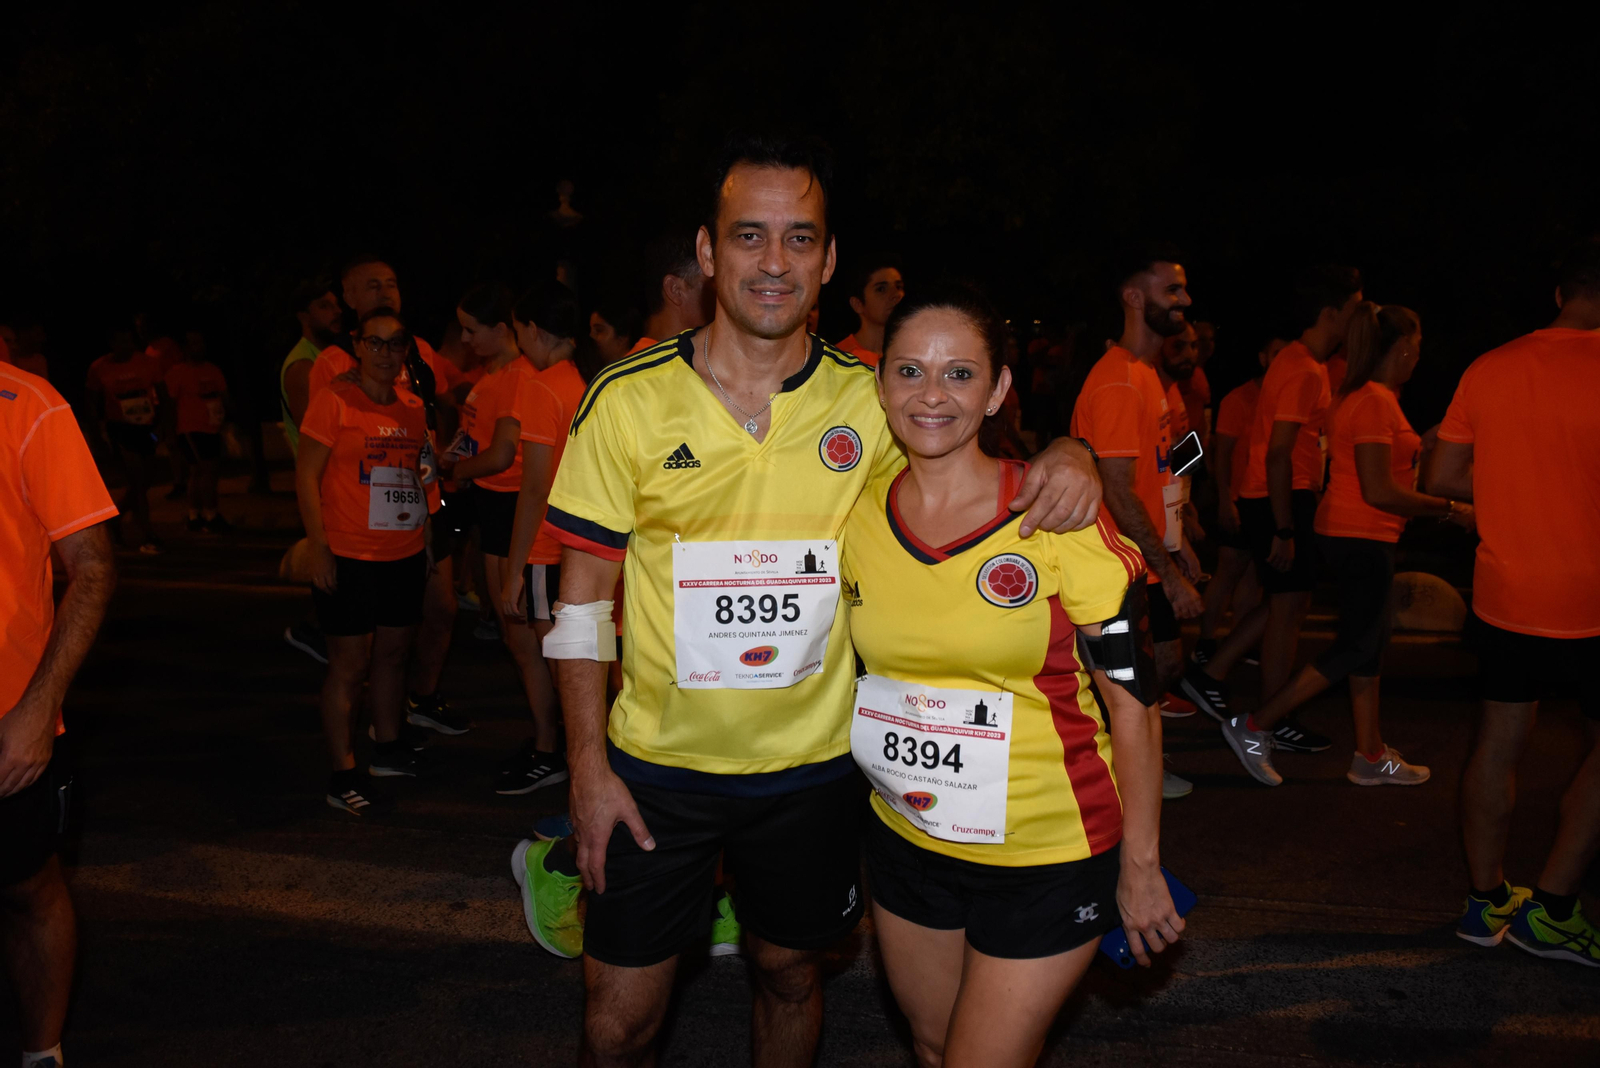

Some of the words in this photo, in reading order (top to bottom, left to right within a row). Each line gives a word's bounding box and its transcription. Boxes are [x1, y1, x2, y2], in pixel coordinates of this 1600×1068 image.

[663, 459, 702, 470] adidas
[384, 490, 420, 504] 19658
[715, 593, 801, 625] 8395
[708, 631, 737, 639] ANDRES
[738, 630, 777, 639] QUINTANA
[778, 629, 808, 637] JIMENEZ
[860, 709, 874, 717] XXXV
[873, 712, 895, 722] CARRERA
[894, 717, 920, 729] NOCTURNA
[920, 724, 930, 732] DEL
[930, 725, 974, 736] GUADALQUIVIR
[883, 731, 964, 774] 8394
[1380, 760, 1401, 775] N
[871, 763, 886, 773] ALBA
[886, 767, 907, 779] ROCIO
[907, 774, 943, 786] CASTAÑO
[944, 780, 978, 791] SALAZAR
[951, 824, 996, 836] Cruzcampo
